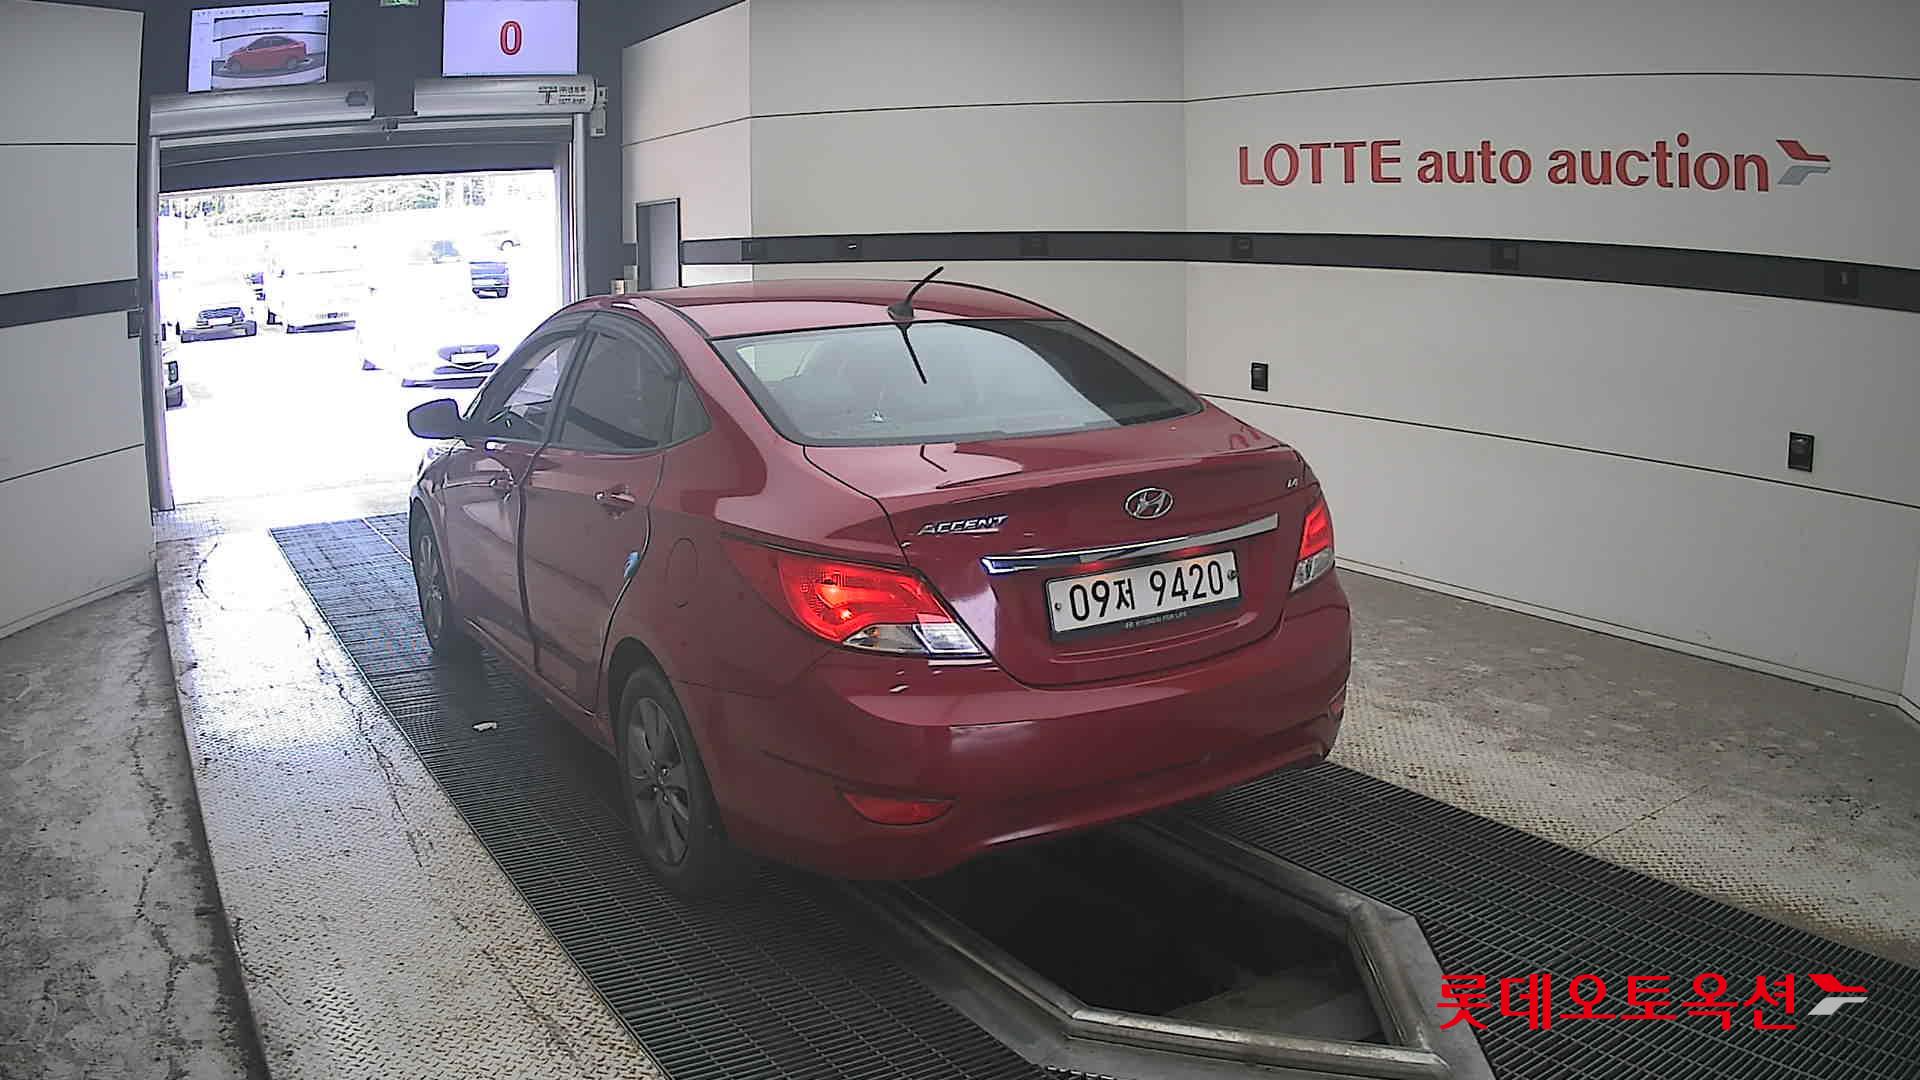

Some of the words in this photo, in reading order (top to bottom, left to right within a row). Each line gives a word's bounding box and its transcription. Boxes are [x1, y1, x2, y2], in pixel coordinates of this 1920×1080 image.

[500, 20, 522, 55] 0
[1239, 139, 1402, 187] LOTTE
[1417, 140, 1532, 185] auto
[1548, 132, 1769, 192] auction
[917, 514, 1008, 536] ACCENT
[1069, 577, 1136, 622] 09저
[1149, 560, 1225, 608] 9420
